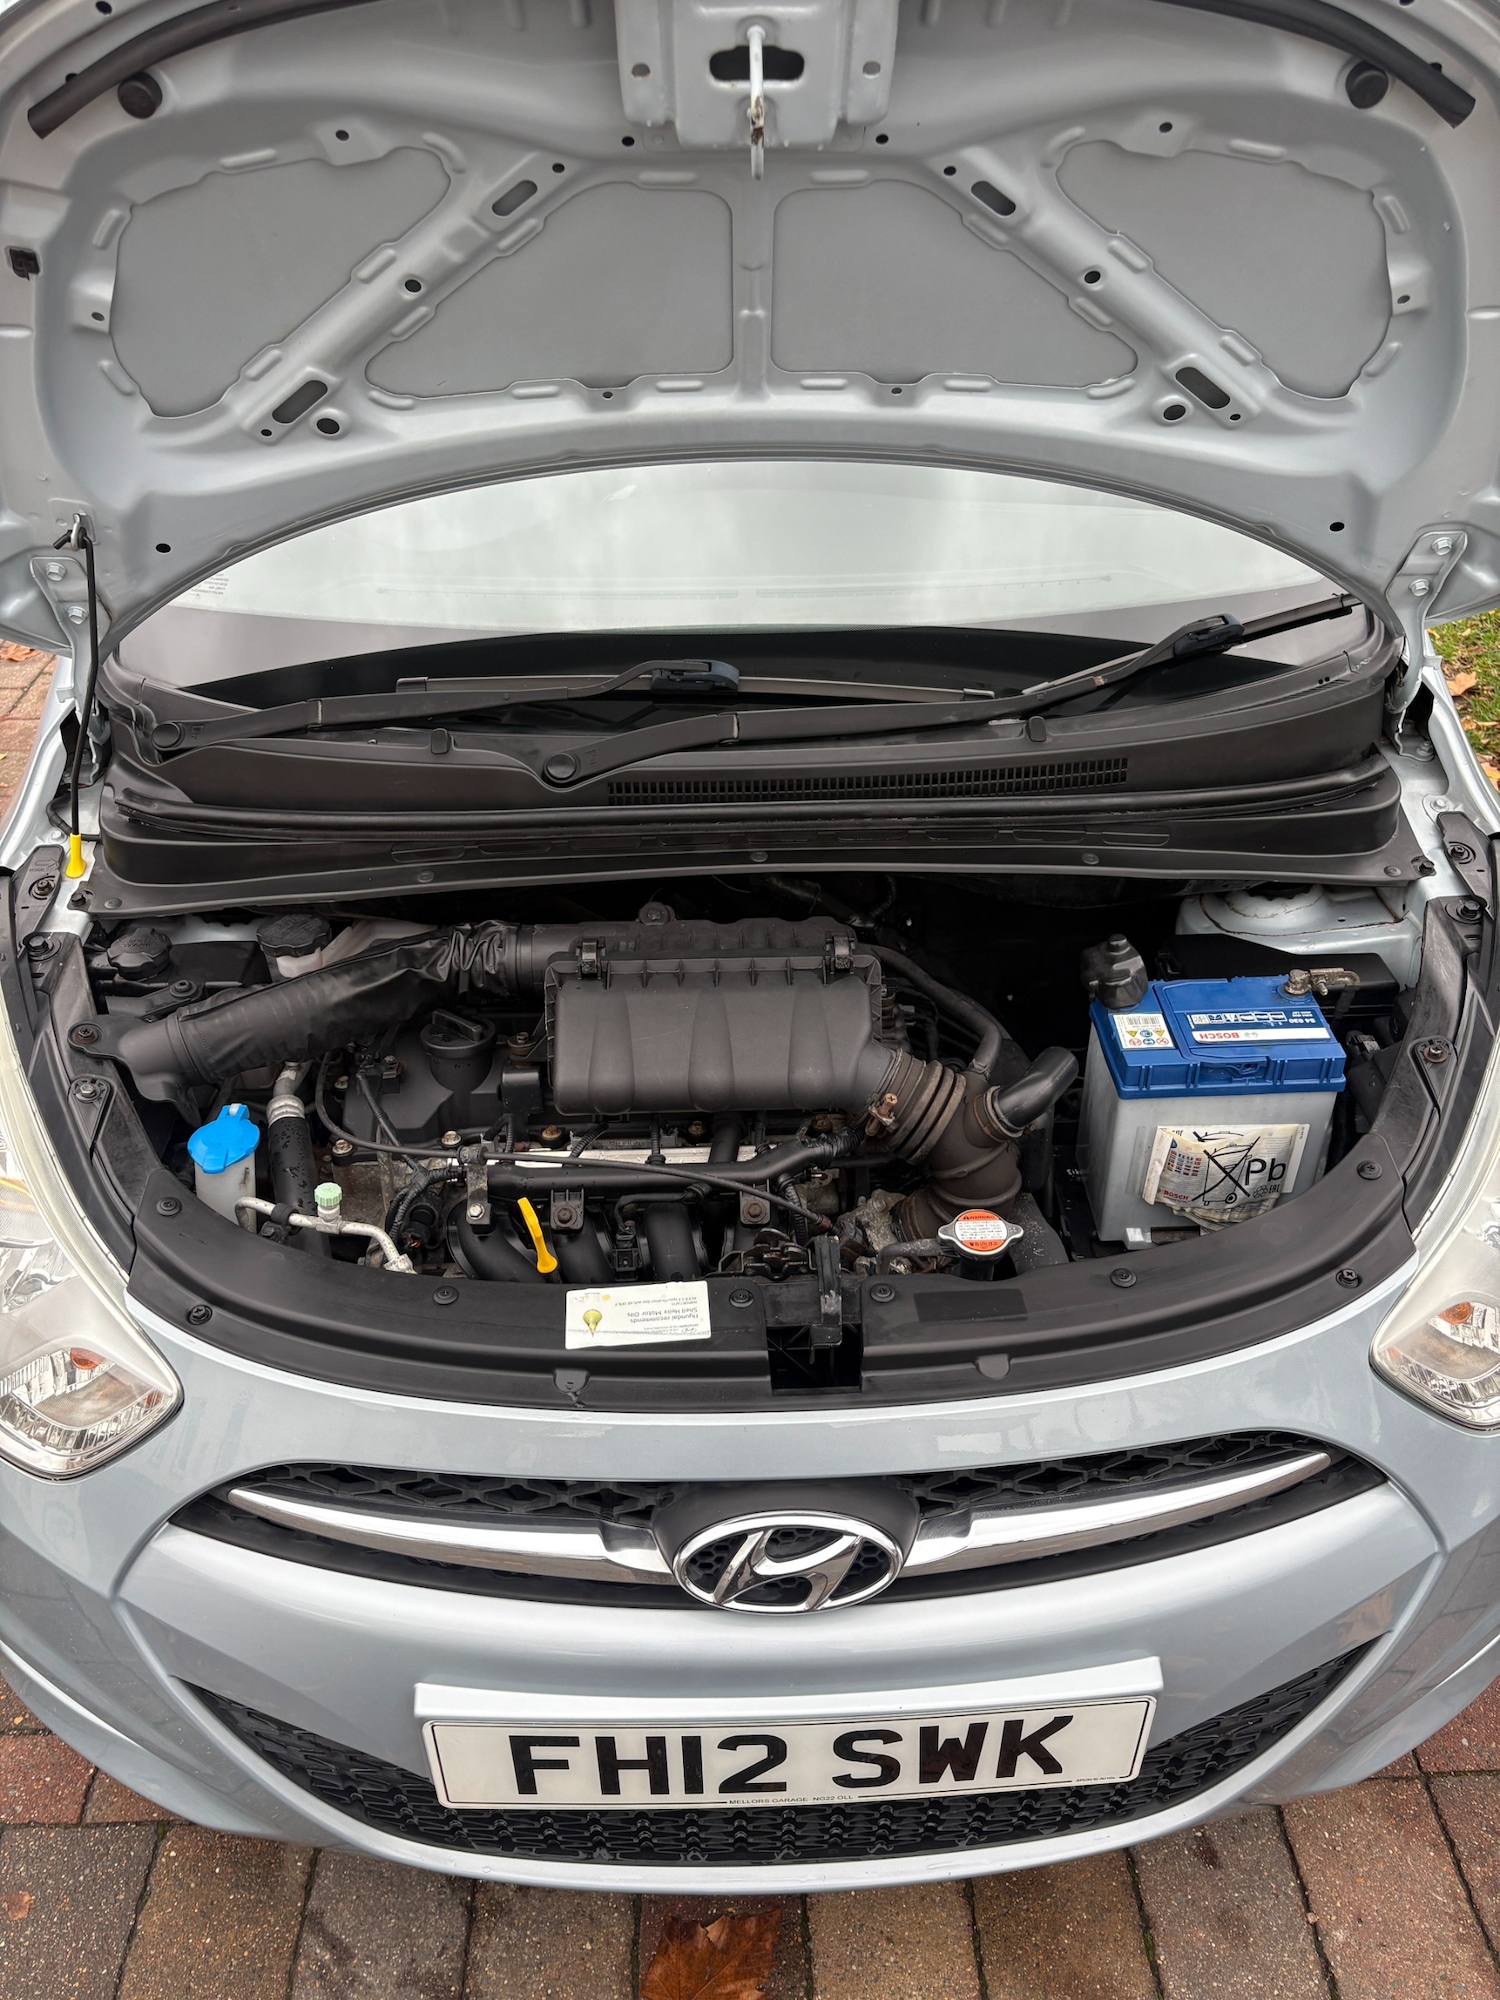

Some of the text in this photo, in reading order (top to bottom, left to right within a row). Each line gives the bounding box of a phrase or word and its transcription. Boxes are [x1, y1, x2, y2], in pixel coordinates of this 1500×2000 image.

[1199, 1032, 1240, 1040] BOSCH
[1244, 1158, 1287, 1186] Pb
[1163, 1189, 1189, 1201] BOSCH
[630, 1316, 670, 1324] recommends
[508, 1715, 1074, 1796] FH12 SWK
